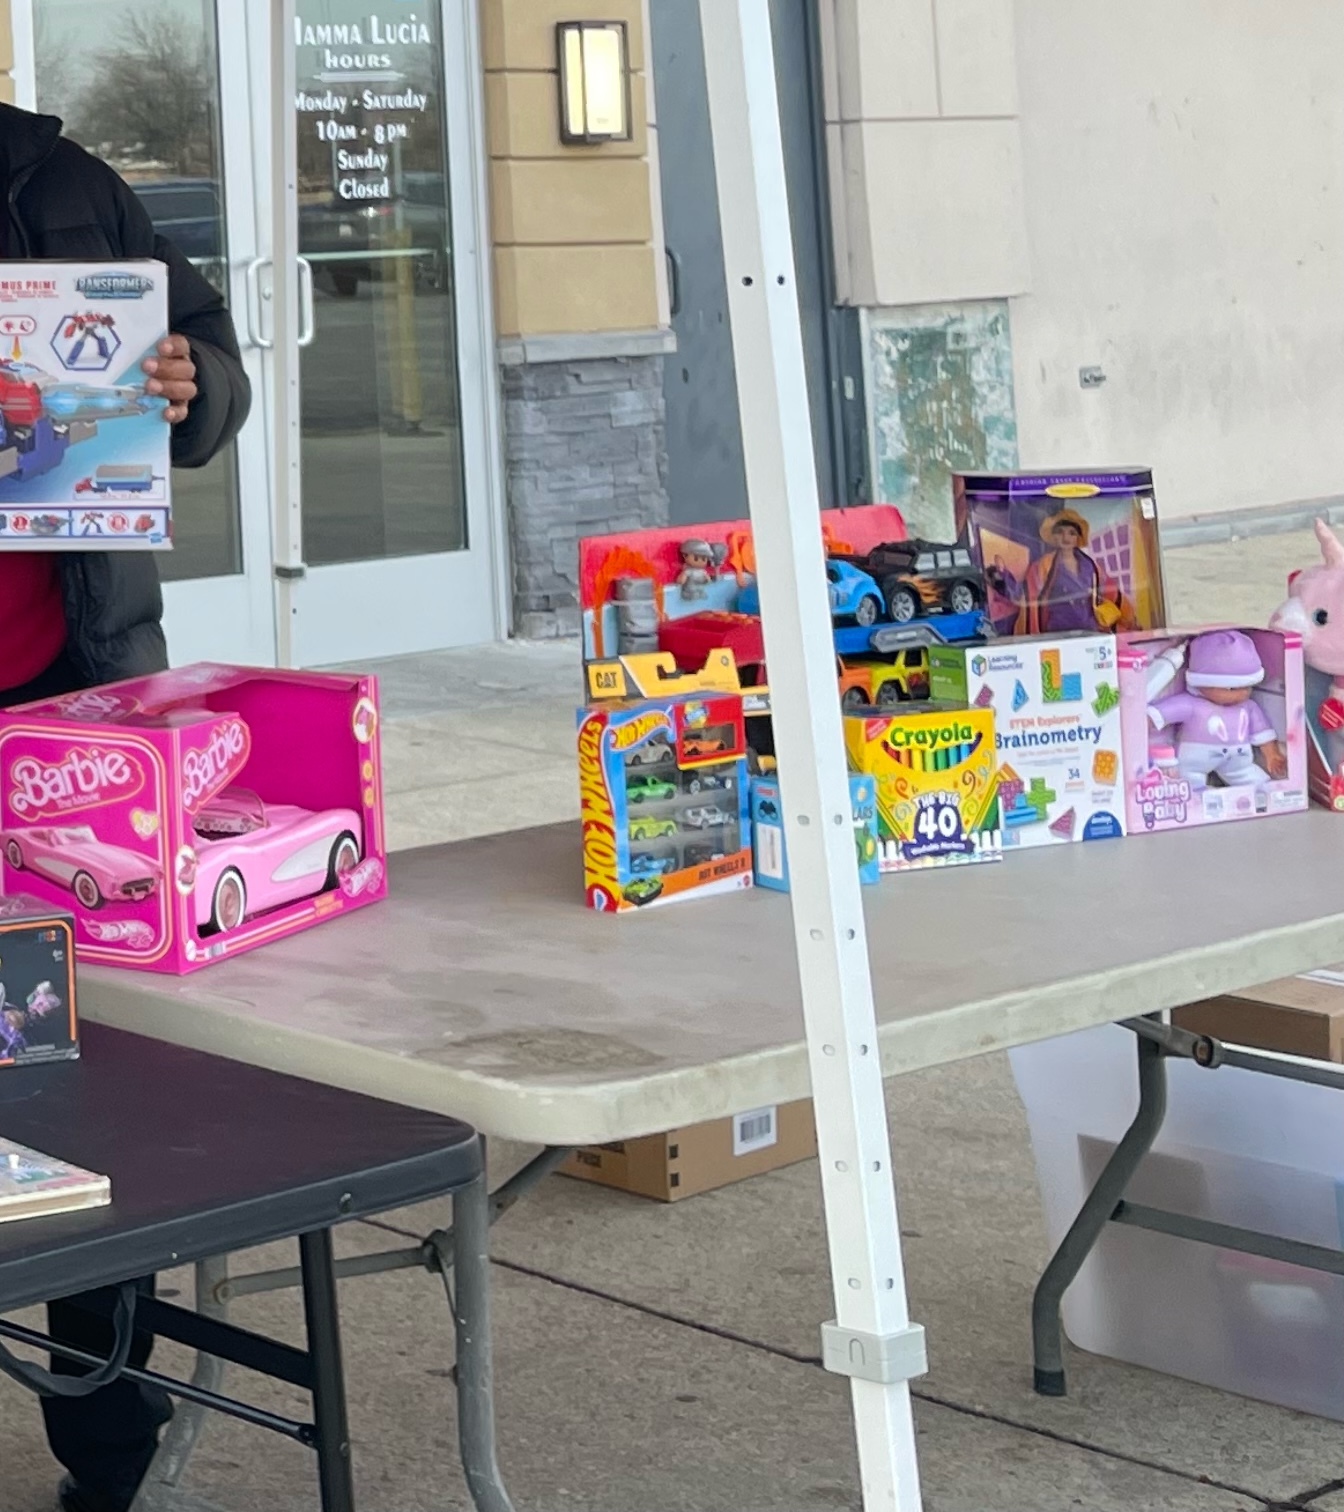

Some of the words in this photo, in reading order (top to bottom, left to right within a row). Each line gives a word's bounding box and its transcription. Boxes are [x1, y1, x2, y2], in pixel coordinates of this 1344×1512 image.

[25, 280, 57, 290] PRIME
[596, 671, 617, 688] CAT
[890, 723, 973, 749] Crayola
[183, 722, 243, 807] Barbie
[13, 749, 131, 812] Barbie
[918, 806, 958, 839] 40
